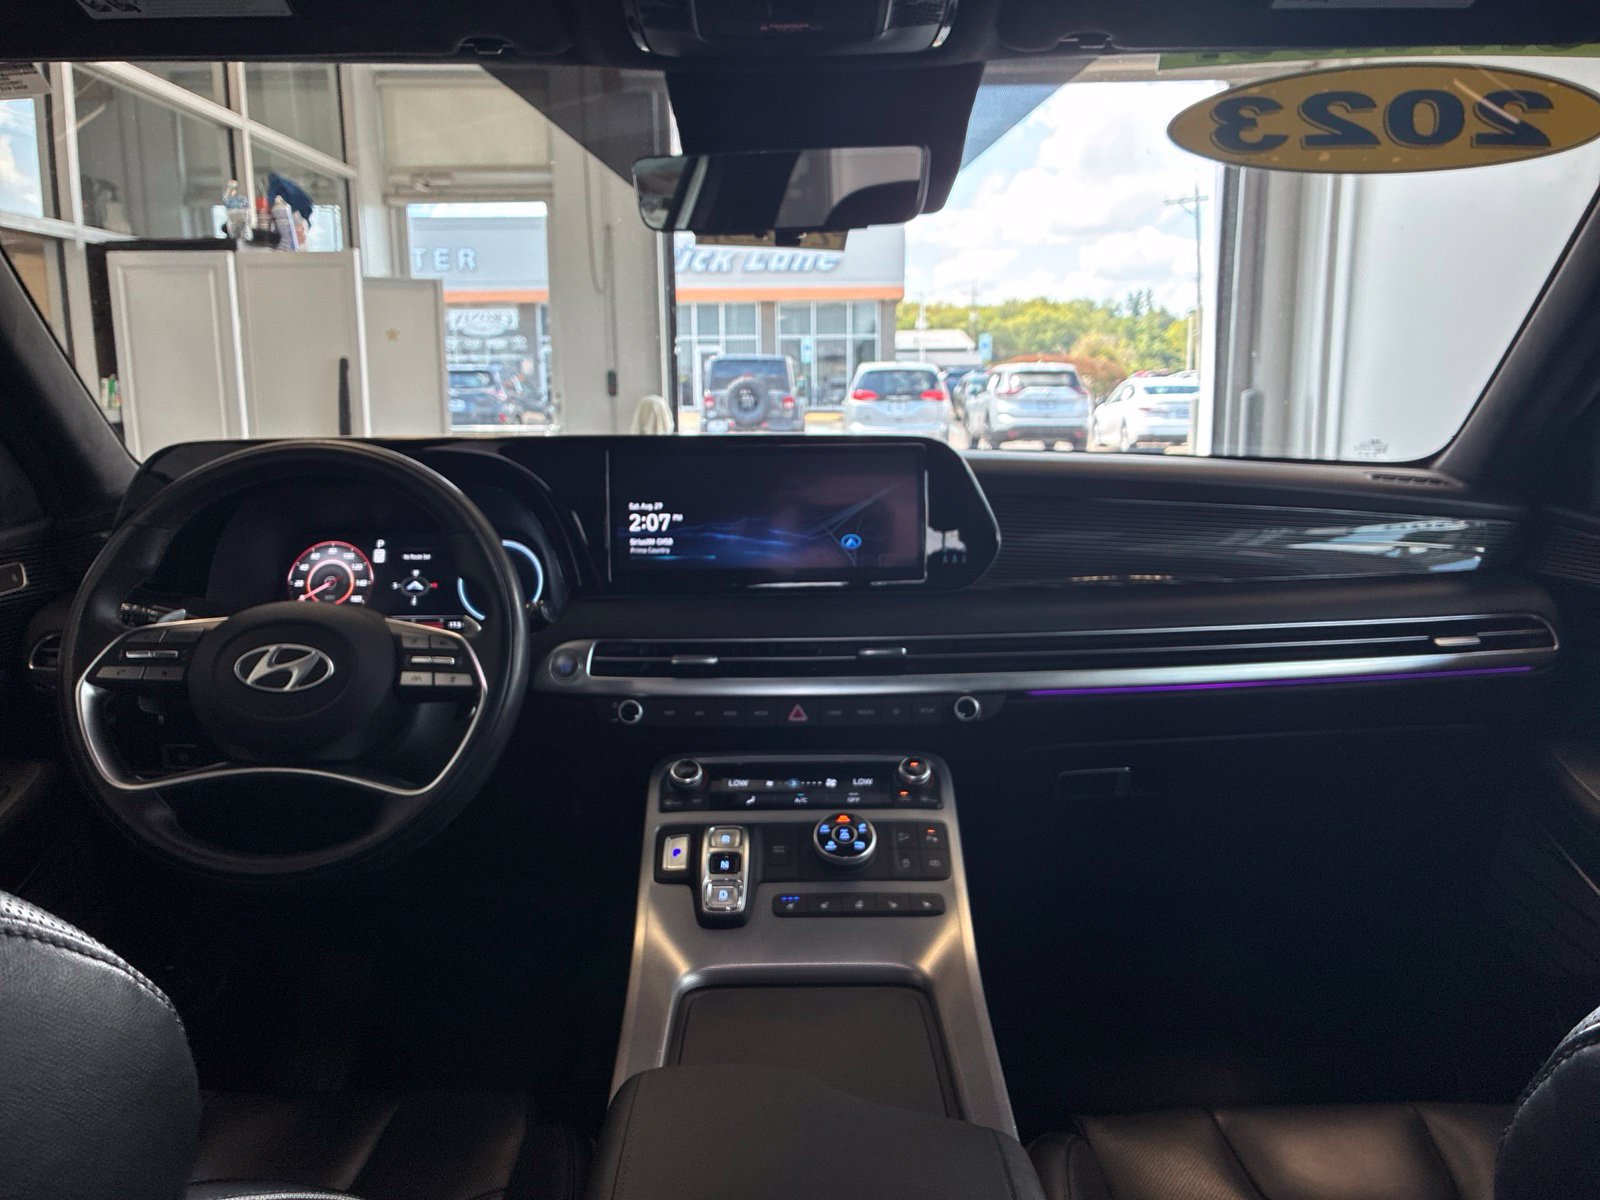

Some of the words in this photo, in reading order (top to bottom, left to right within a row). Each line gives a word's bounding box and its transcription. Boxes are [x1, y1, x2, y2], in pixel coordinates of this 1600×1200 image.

[628, 513, 671, 532] 2:07
[375, 539, 385, 548] P
[728, 780, 749, 788] LOW
[852, 778, 873, 786] LOW
[718, 890, 728, 902] D
